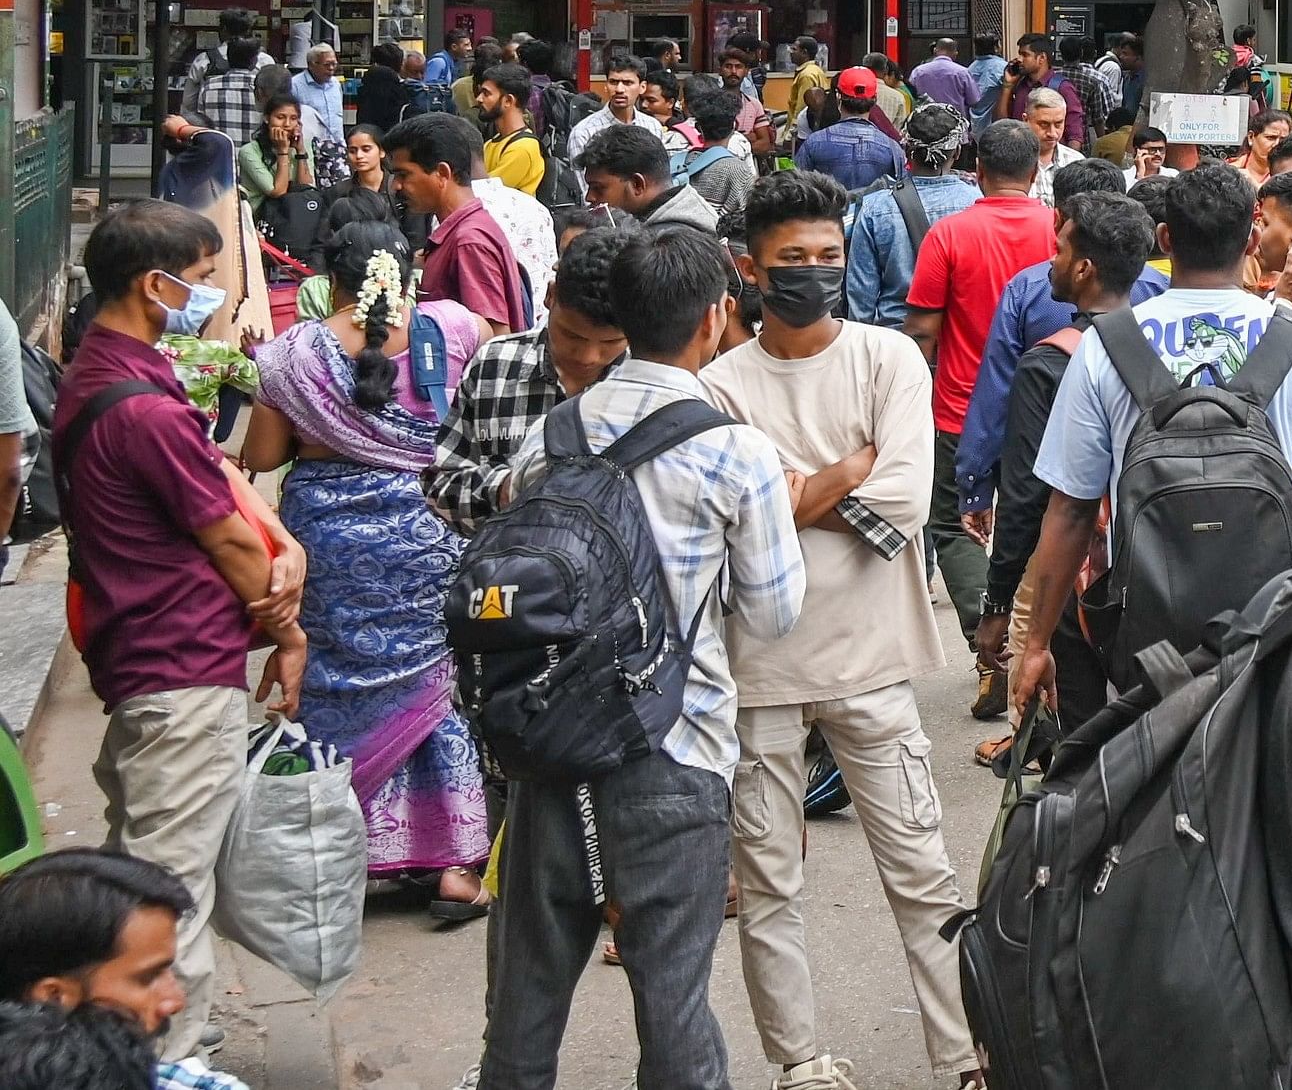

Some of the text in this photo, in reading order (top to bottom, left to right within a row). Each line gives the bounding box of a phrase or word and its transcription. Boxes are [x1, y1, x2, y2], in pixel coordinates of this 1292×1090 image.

[1203, 123, 1220, 131] FOR
[1198, 133, 1237, 141] PORTERS
[468, 585, 519, 620] CAT
